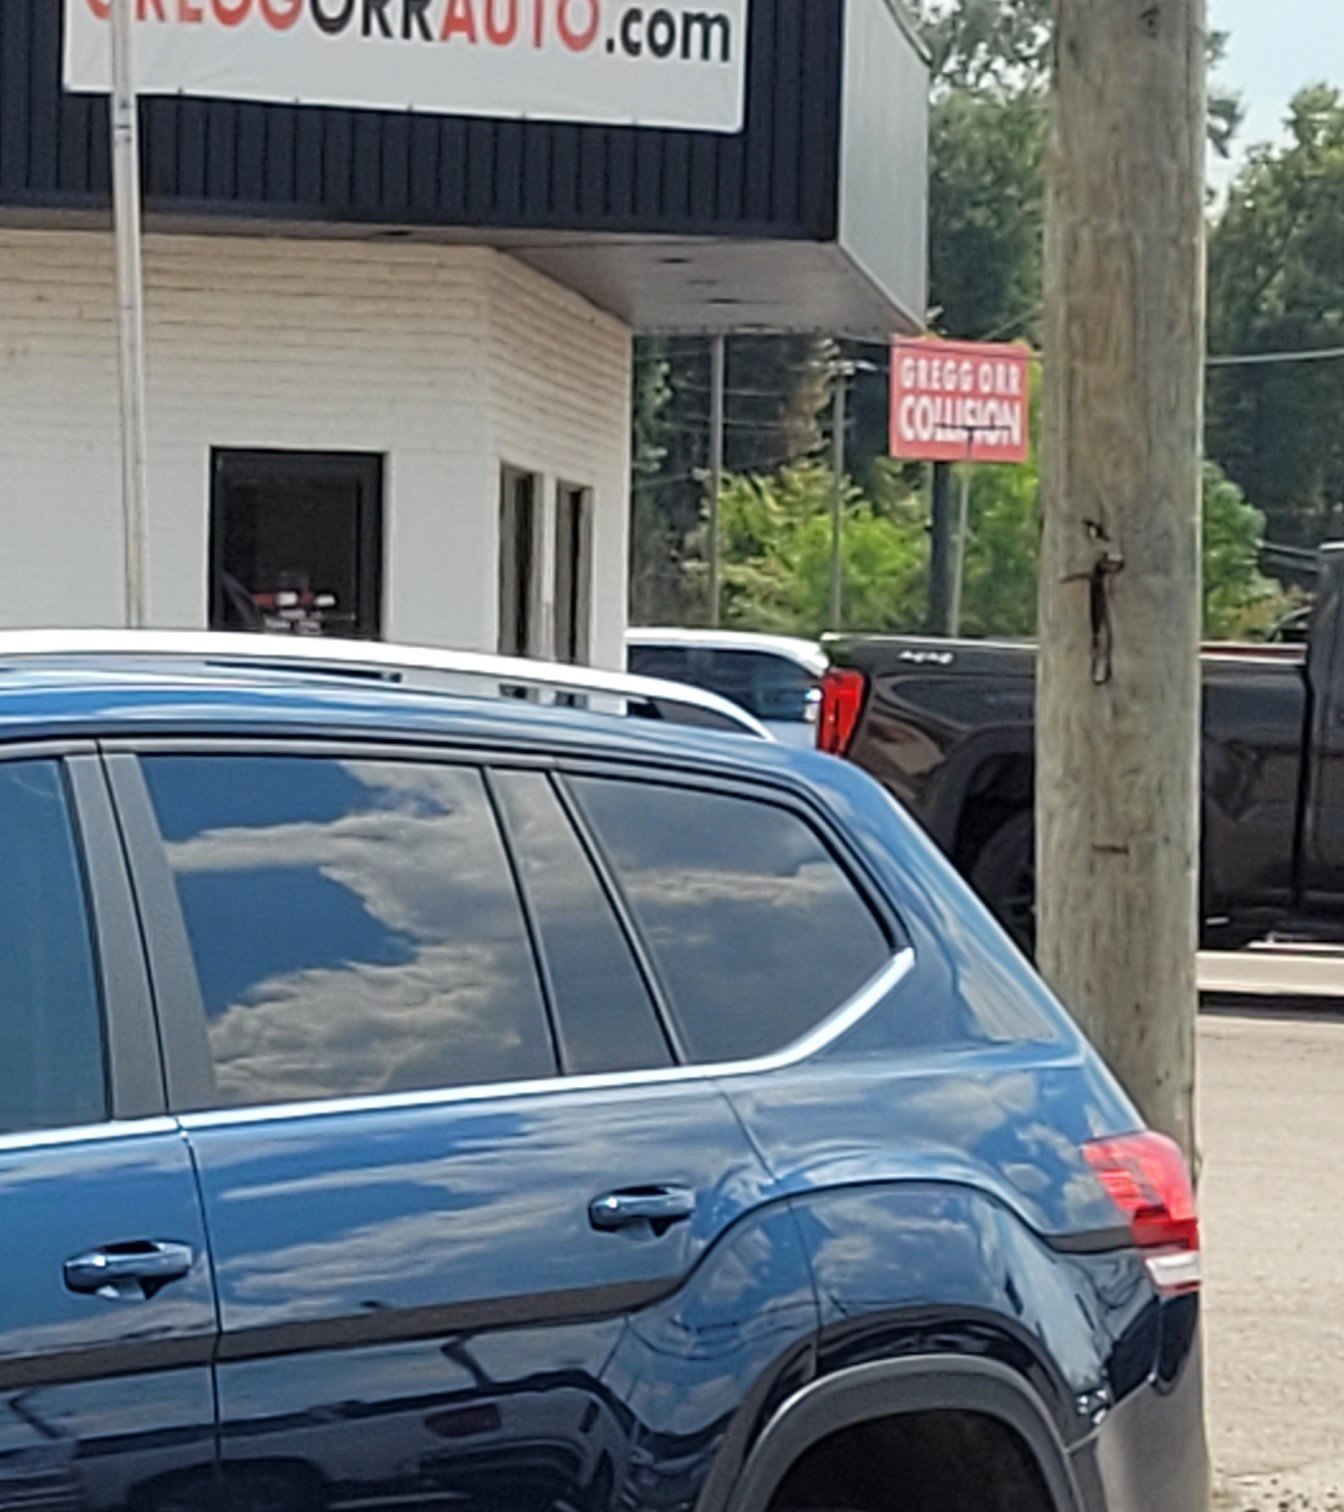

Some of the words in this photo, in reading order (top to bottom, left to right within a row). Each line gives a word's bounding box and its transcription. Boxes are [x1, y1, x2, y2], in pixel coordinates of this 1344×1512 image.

[901, 356, 975, 392] GREGG
[978, 362, 1021, 396] ORR
[899, 395, 1022, 447] COLLISION
